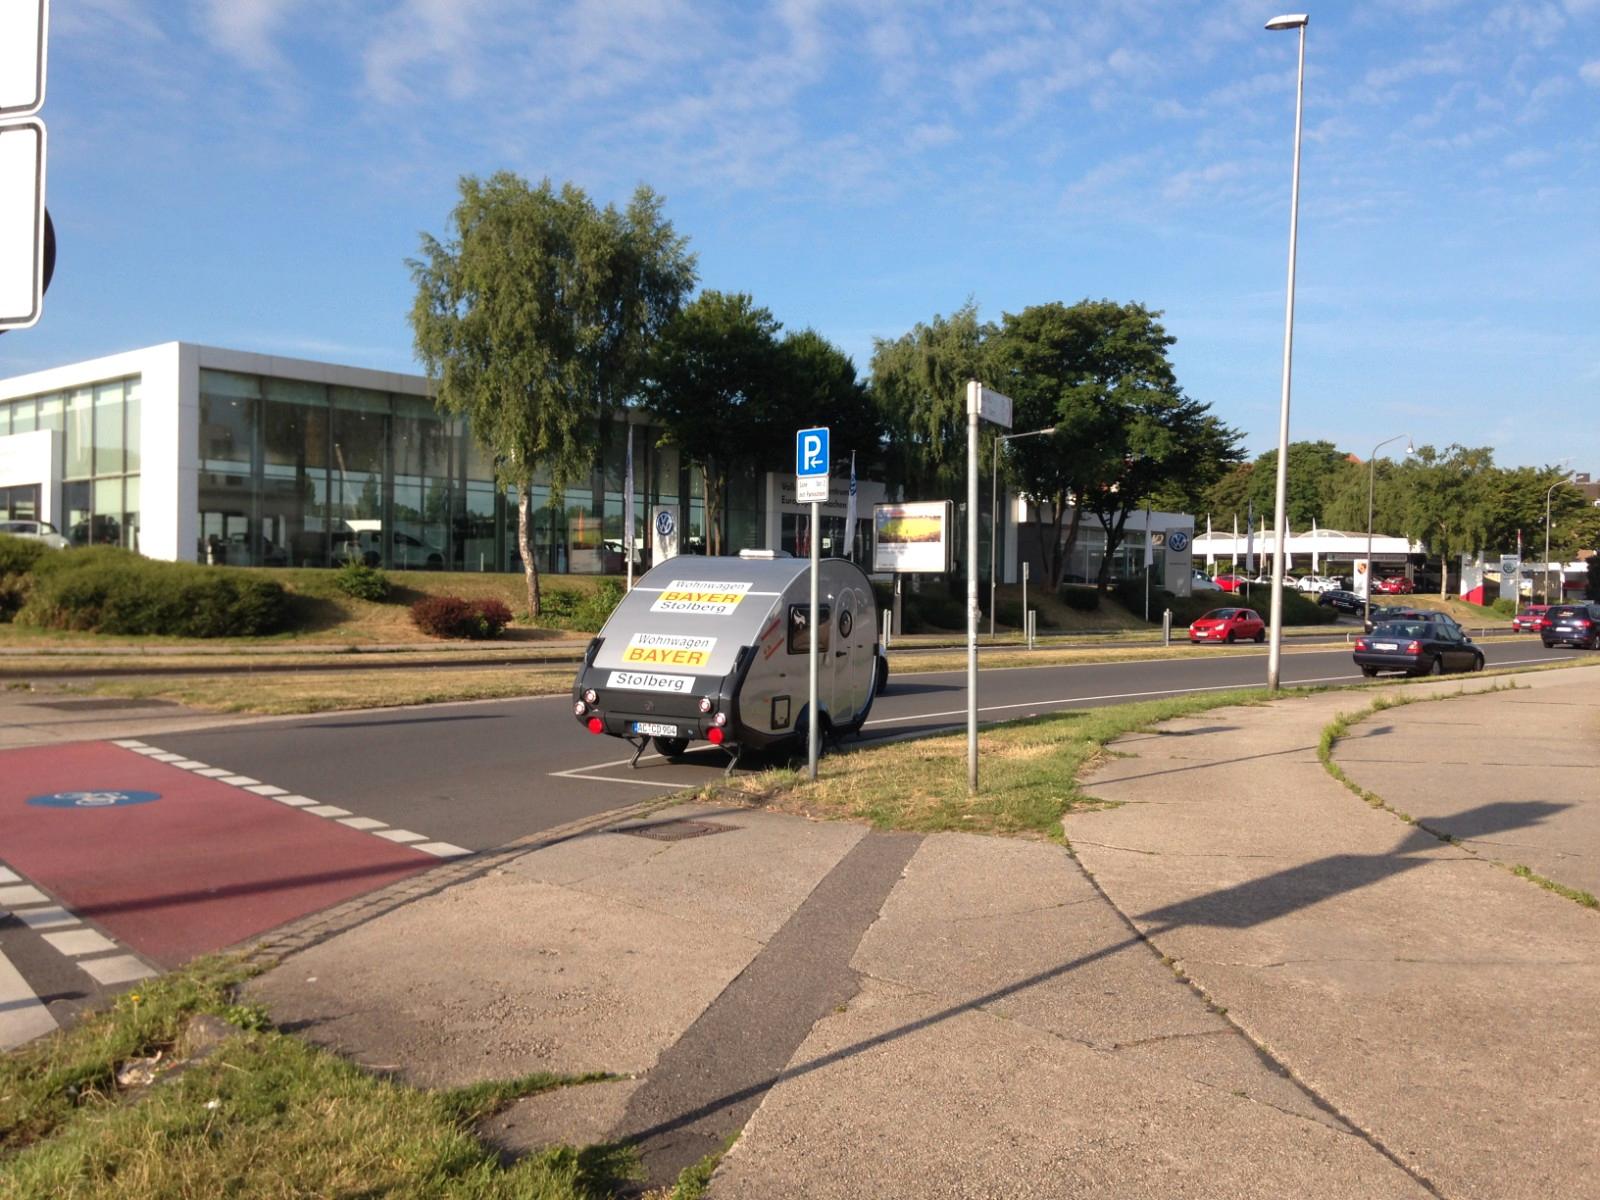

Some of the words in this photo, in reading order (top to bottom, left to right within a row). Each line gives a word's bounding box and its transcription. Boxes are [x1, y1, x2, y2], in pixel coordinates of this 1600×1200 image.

[804, 435, 821, 470] P
[676, 581, 745, 591] Wohnwagen
[665, 592, 738, 603] BAYER
[660, 602, 726, 613] Stolberg
[638, 634, 709, 649] Wohnwagen
[629, 648, 703, 664] BAYER
[616, 673, 684, 690] Stolberg
